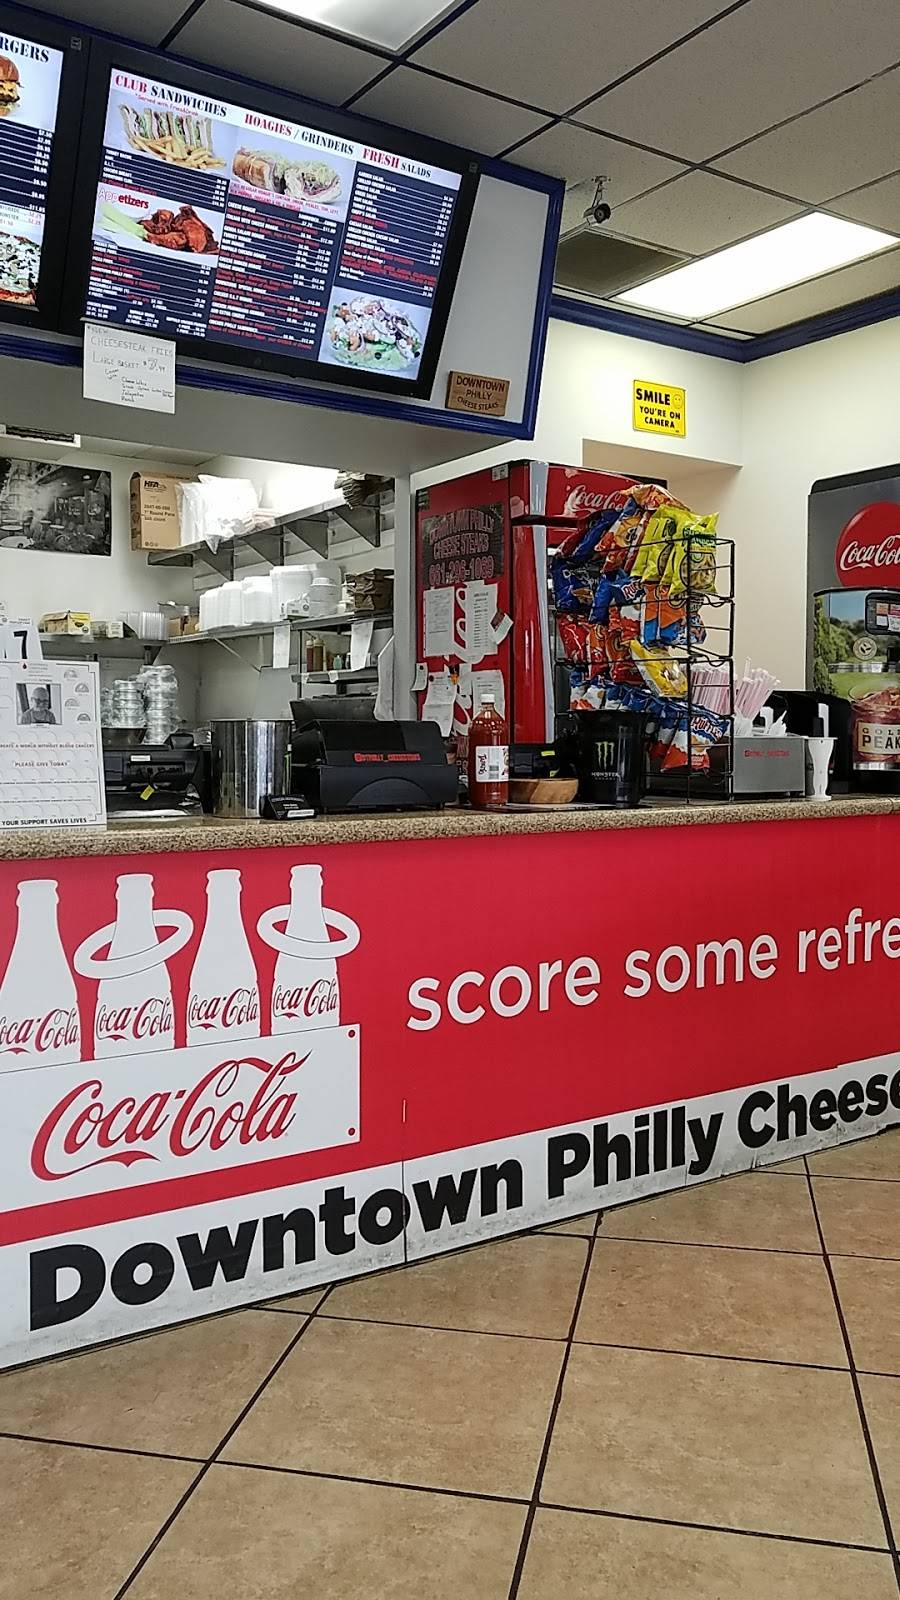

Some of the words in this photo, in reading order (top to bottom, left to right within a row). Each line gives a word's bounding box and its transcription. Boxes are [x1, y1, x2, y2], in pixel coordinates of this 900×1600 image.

[115, 74, 148, 94] CLUB
[150, 85, 228, 118] SANDWICHES
[244, 113, 293, 137] HOAGIES
[301, 130, 354, 155] GRINDERS
[362, 148, 400, 169] FRESH
[400, 162, 432, 179] SALADS
[97, 189, 150, 209] Appetizers
[456, 375, 506, 392] DOWNTOWN
[465, 389, 493, 401] PHILLY
[636, 388, 671, 406] SMILE
[640, 405, 667, 418] YOU'RE
[670, 411, 681, 420] ON
[644, 416, 675, 429] CAMERA
[13, 630, 28, 660] 7
[406, 956, 601, 1031] score
[623, 934, 778, 999] some
[798, 907, 900, 973] refre
[188, 988, 259, 1030] Coca-Cola
[272, 978, 339, 1018] Coca-Cola
[96, 997, 173, 1042] Coca-Cola
[30, 1049, 313, 1182] Coca-Cola
[29, 1159, 524, 1332] Downtown
[547, 1105, 724, 1201] Philly
